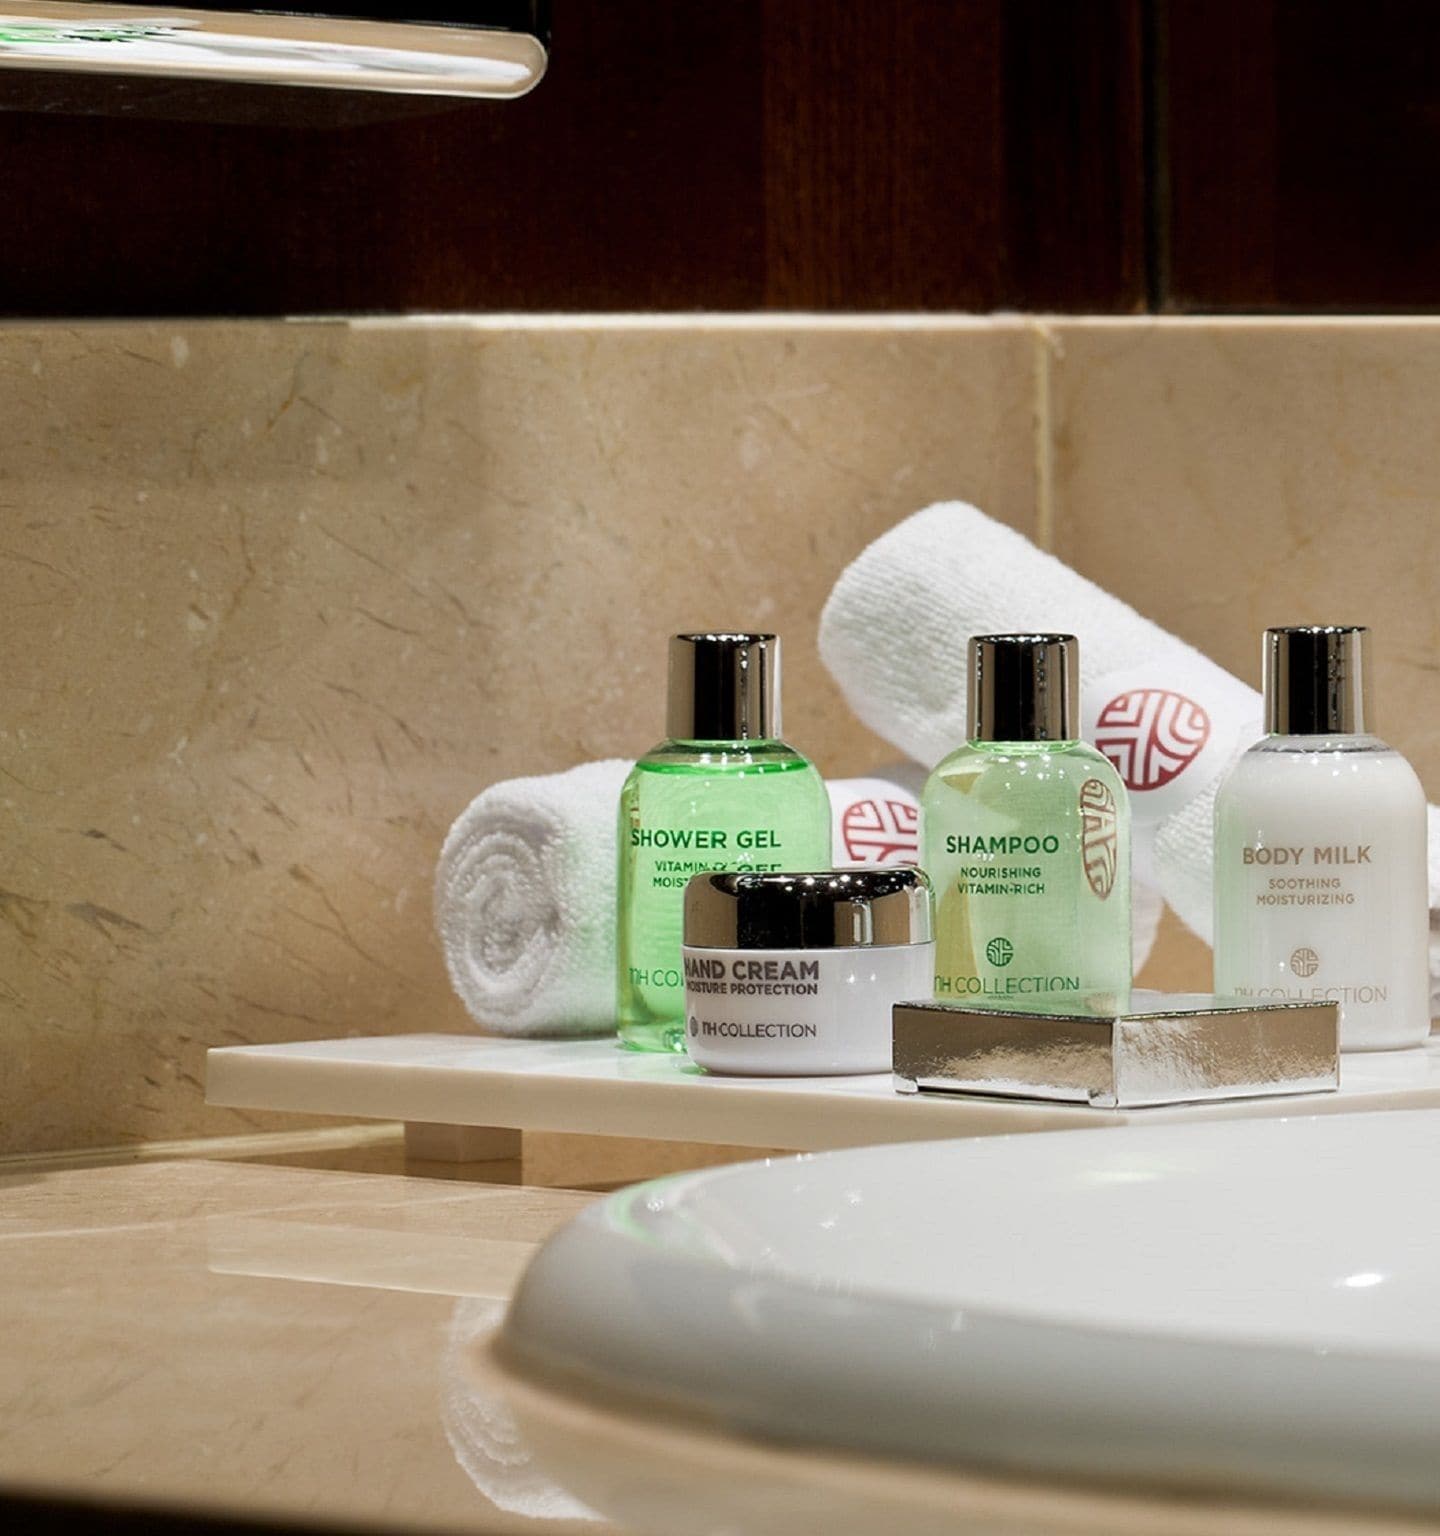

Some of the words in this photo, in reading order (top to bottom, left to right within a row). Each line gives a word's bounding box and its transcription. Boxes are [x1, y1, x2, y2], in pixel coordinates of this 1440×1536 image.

[631, 829, 727, 848] SHOWER
[736, 830, 782, 848] GEL
[946, 835, 1059, 854] SHAMPOO
[1242, 847, 1304, 865] BODY
[1313, 845, 1372, 864] MILK
[960, 867, 1041, 878] NOURISHING
[1268, 878, 1341, 889] SOOTHING
[1255, 894, 1355, 906] MOISTURIZING
[652, 969, 684, 987] CO
[684, 958, 725, 980] HAND
[732, 960, 819, 980] CREAM
[730, 983, 818, 995] PROTECTION
[955, 976, 1080, 994] COLLECTION
[719, 1022, 817, 1038] COLLECTION
